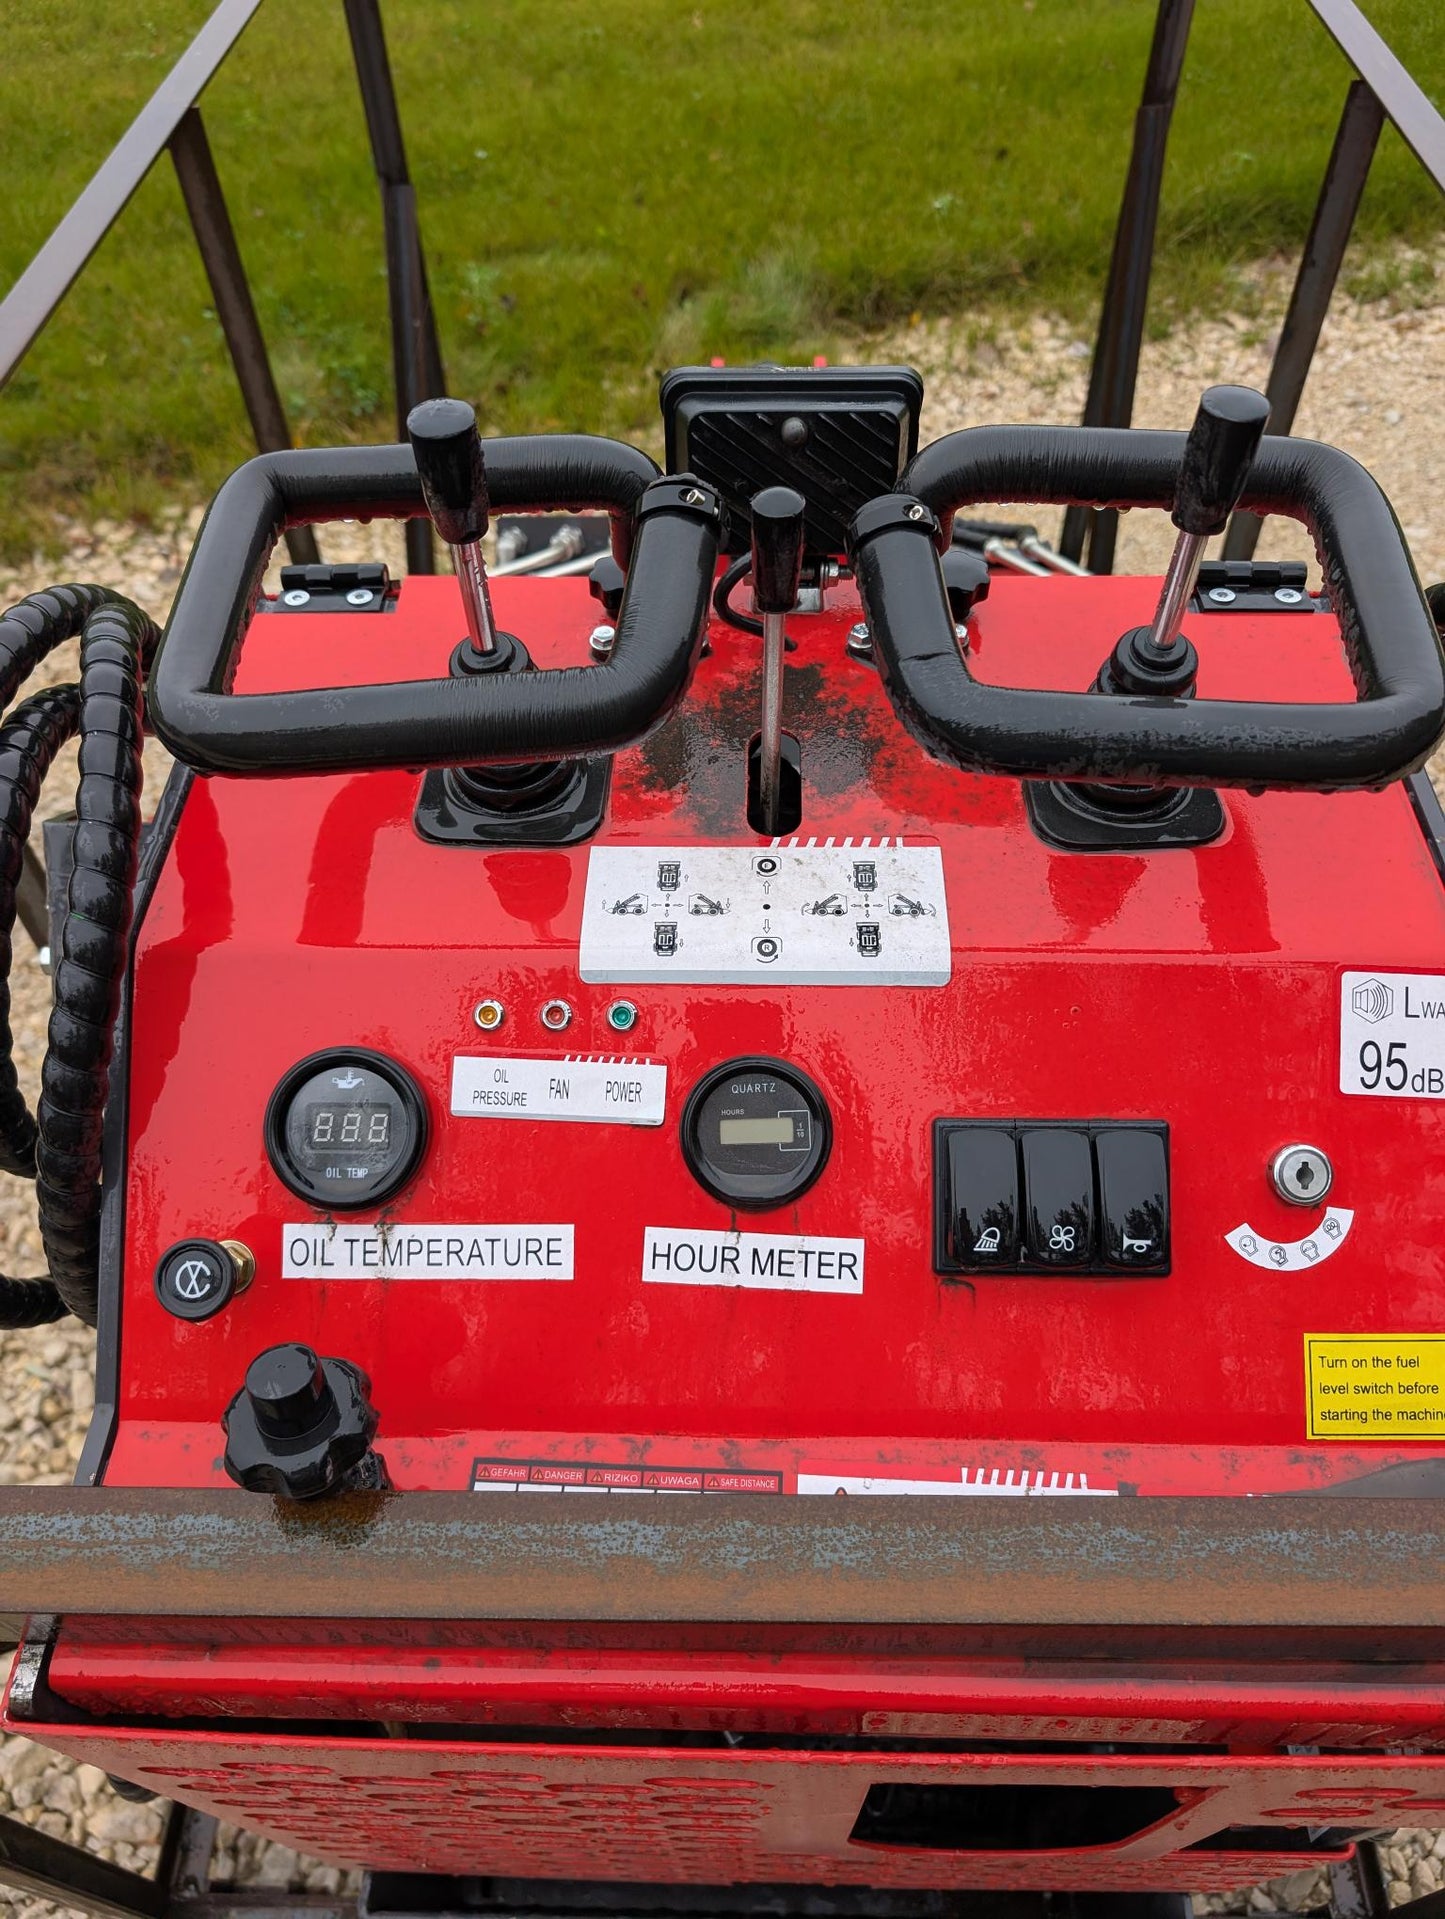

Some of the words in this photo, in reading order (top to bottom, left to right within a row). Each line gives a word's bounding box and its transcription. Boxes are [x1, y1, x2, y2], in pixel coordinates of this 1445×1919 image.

[493, 1067, 509, 1083] OIL
[550, 1078, 570, 1099] FAN
[606, 1080, 642, 1102] POWER
[731, 1082, 776, 1094] QUARTZ
[472, 1090, 527, 1106] PRESSURE
[721, 1108, 745, 1116] HOURS
[326, 1167, 342, 1178] OIL
[347, 1168, 368, 1179] TEMP
[289, 1238, 335, 1267] OIL
[343, 1238, 562, 1267] TEMPERATURE
[651, 1242, 740, 1274] HOUR
[751, 1247, 858, 1280] METER
[1318, 1355, 1347, 1368] Turn
[1351, 1358, 1367, 1368] on
[1372, 1355, 1392, 1368] the
[1396, 1355, 1419, 1368] fuel
[1319, 1382, 1348, 1394] level
[1353, 1382, 1393, 1394] switch
[1398, 1382, 1438, 1394] before
[1320, 1409, 1367, 1424] starting
[1372, 1408, 1392, 1421] the
[490, 1467, 526, 1478] GEFAHR
[544, 1470, 582, 1480] DANGER
[604, 1473, 638, 1483] RIZIKO
[660, 1476, 699, 1486] UWAGA
[720, 1477, 739, 1487] SAFE
[741, 1478, 775, 1489] DISTANCE
